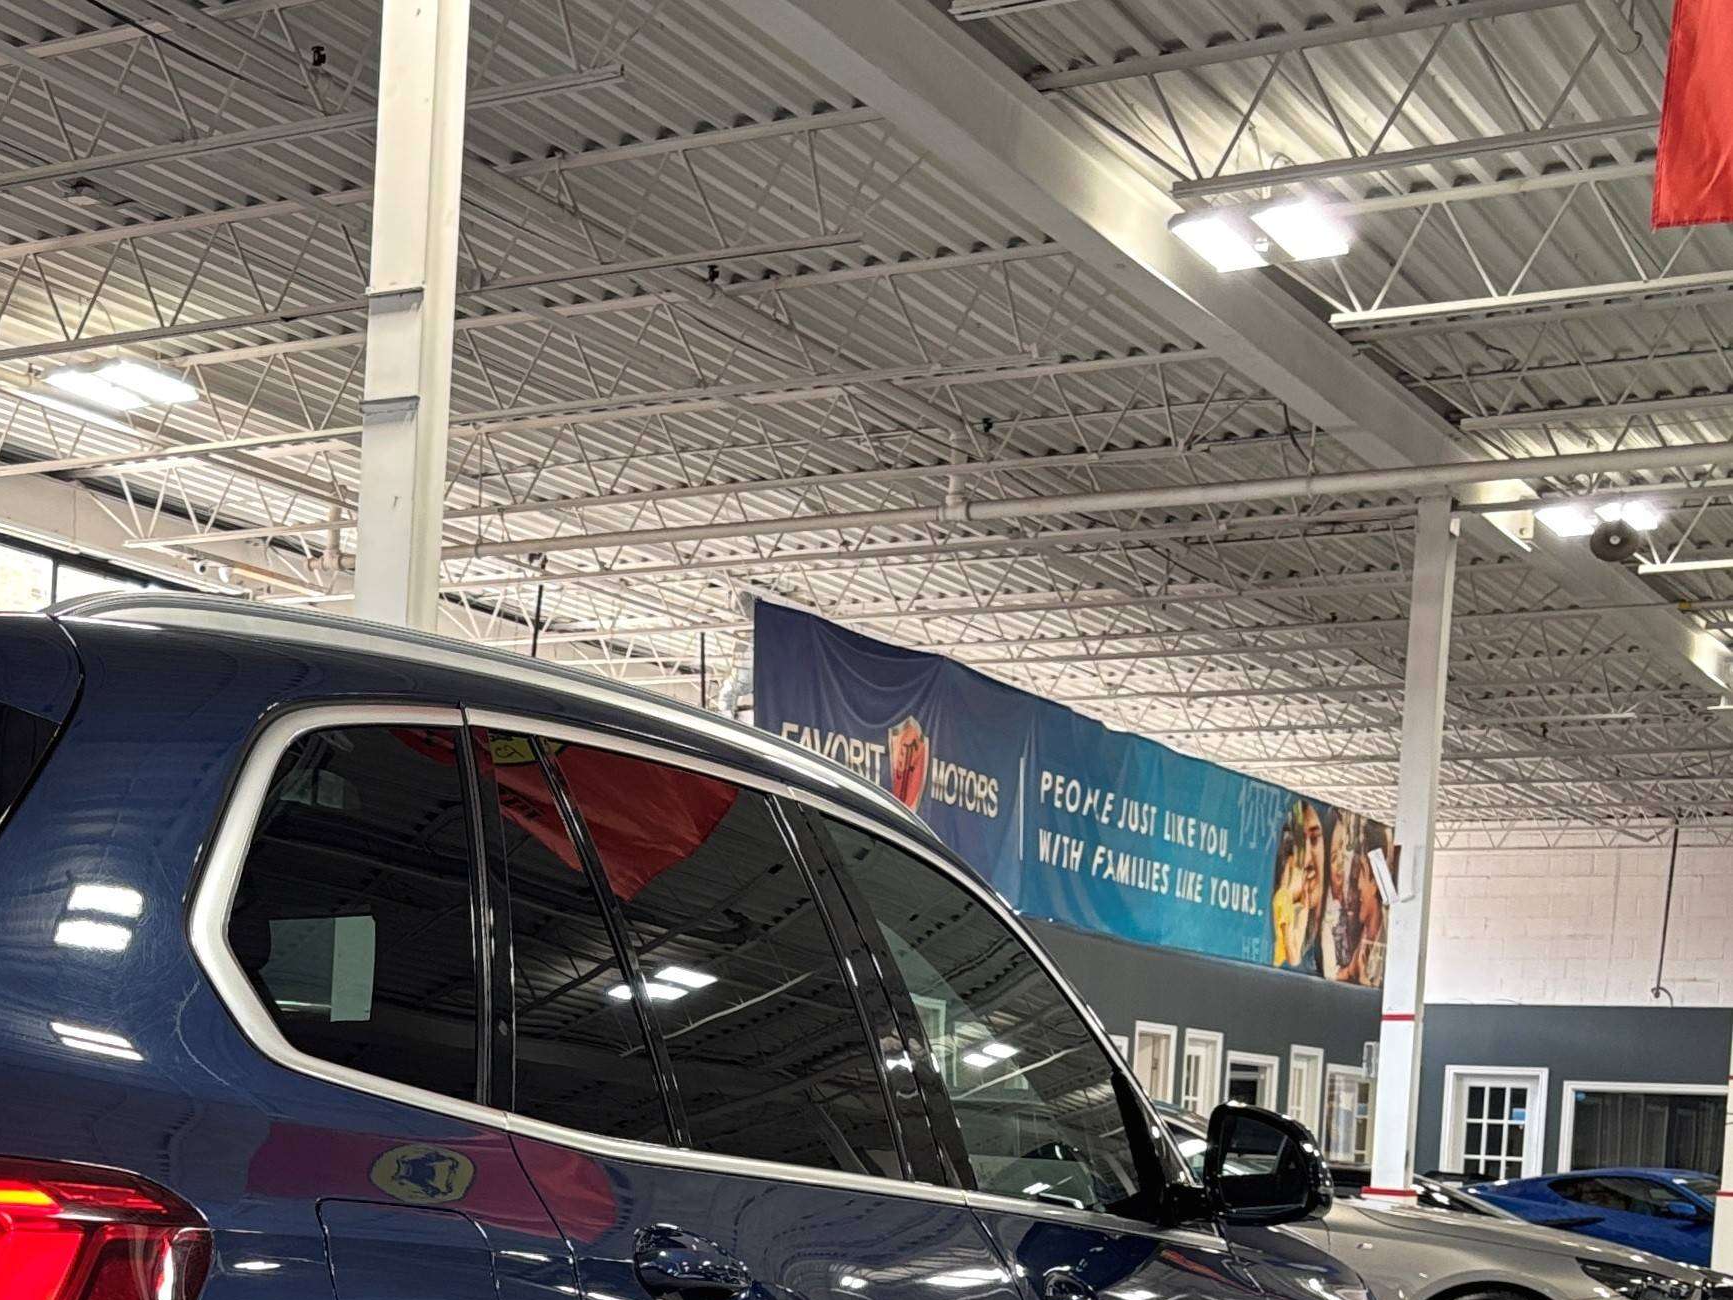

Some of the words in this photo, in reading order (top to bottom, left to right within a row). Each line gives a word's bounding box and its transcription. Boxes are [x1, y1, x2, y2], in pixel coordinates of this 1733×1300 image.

[931, 758, 998, 818] MOTORS
[1117, 798, 1157, 837] JUST
[1164, 811, 1195, 848] LIKE
[1038, 828, 1084, 872] WITH
[1091, 845, 1170, 895] FAMILIES
[1175, 867, 1204, 903] LIKE
